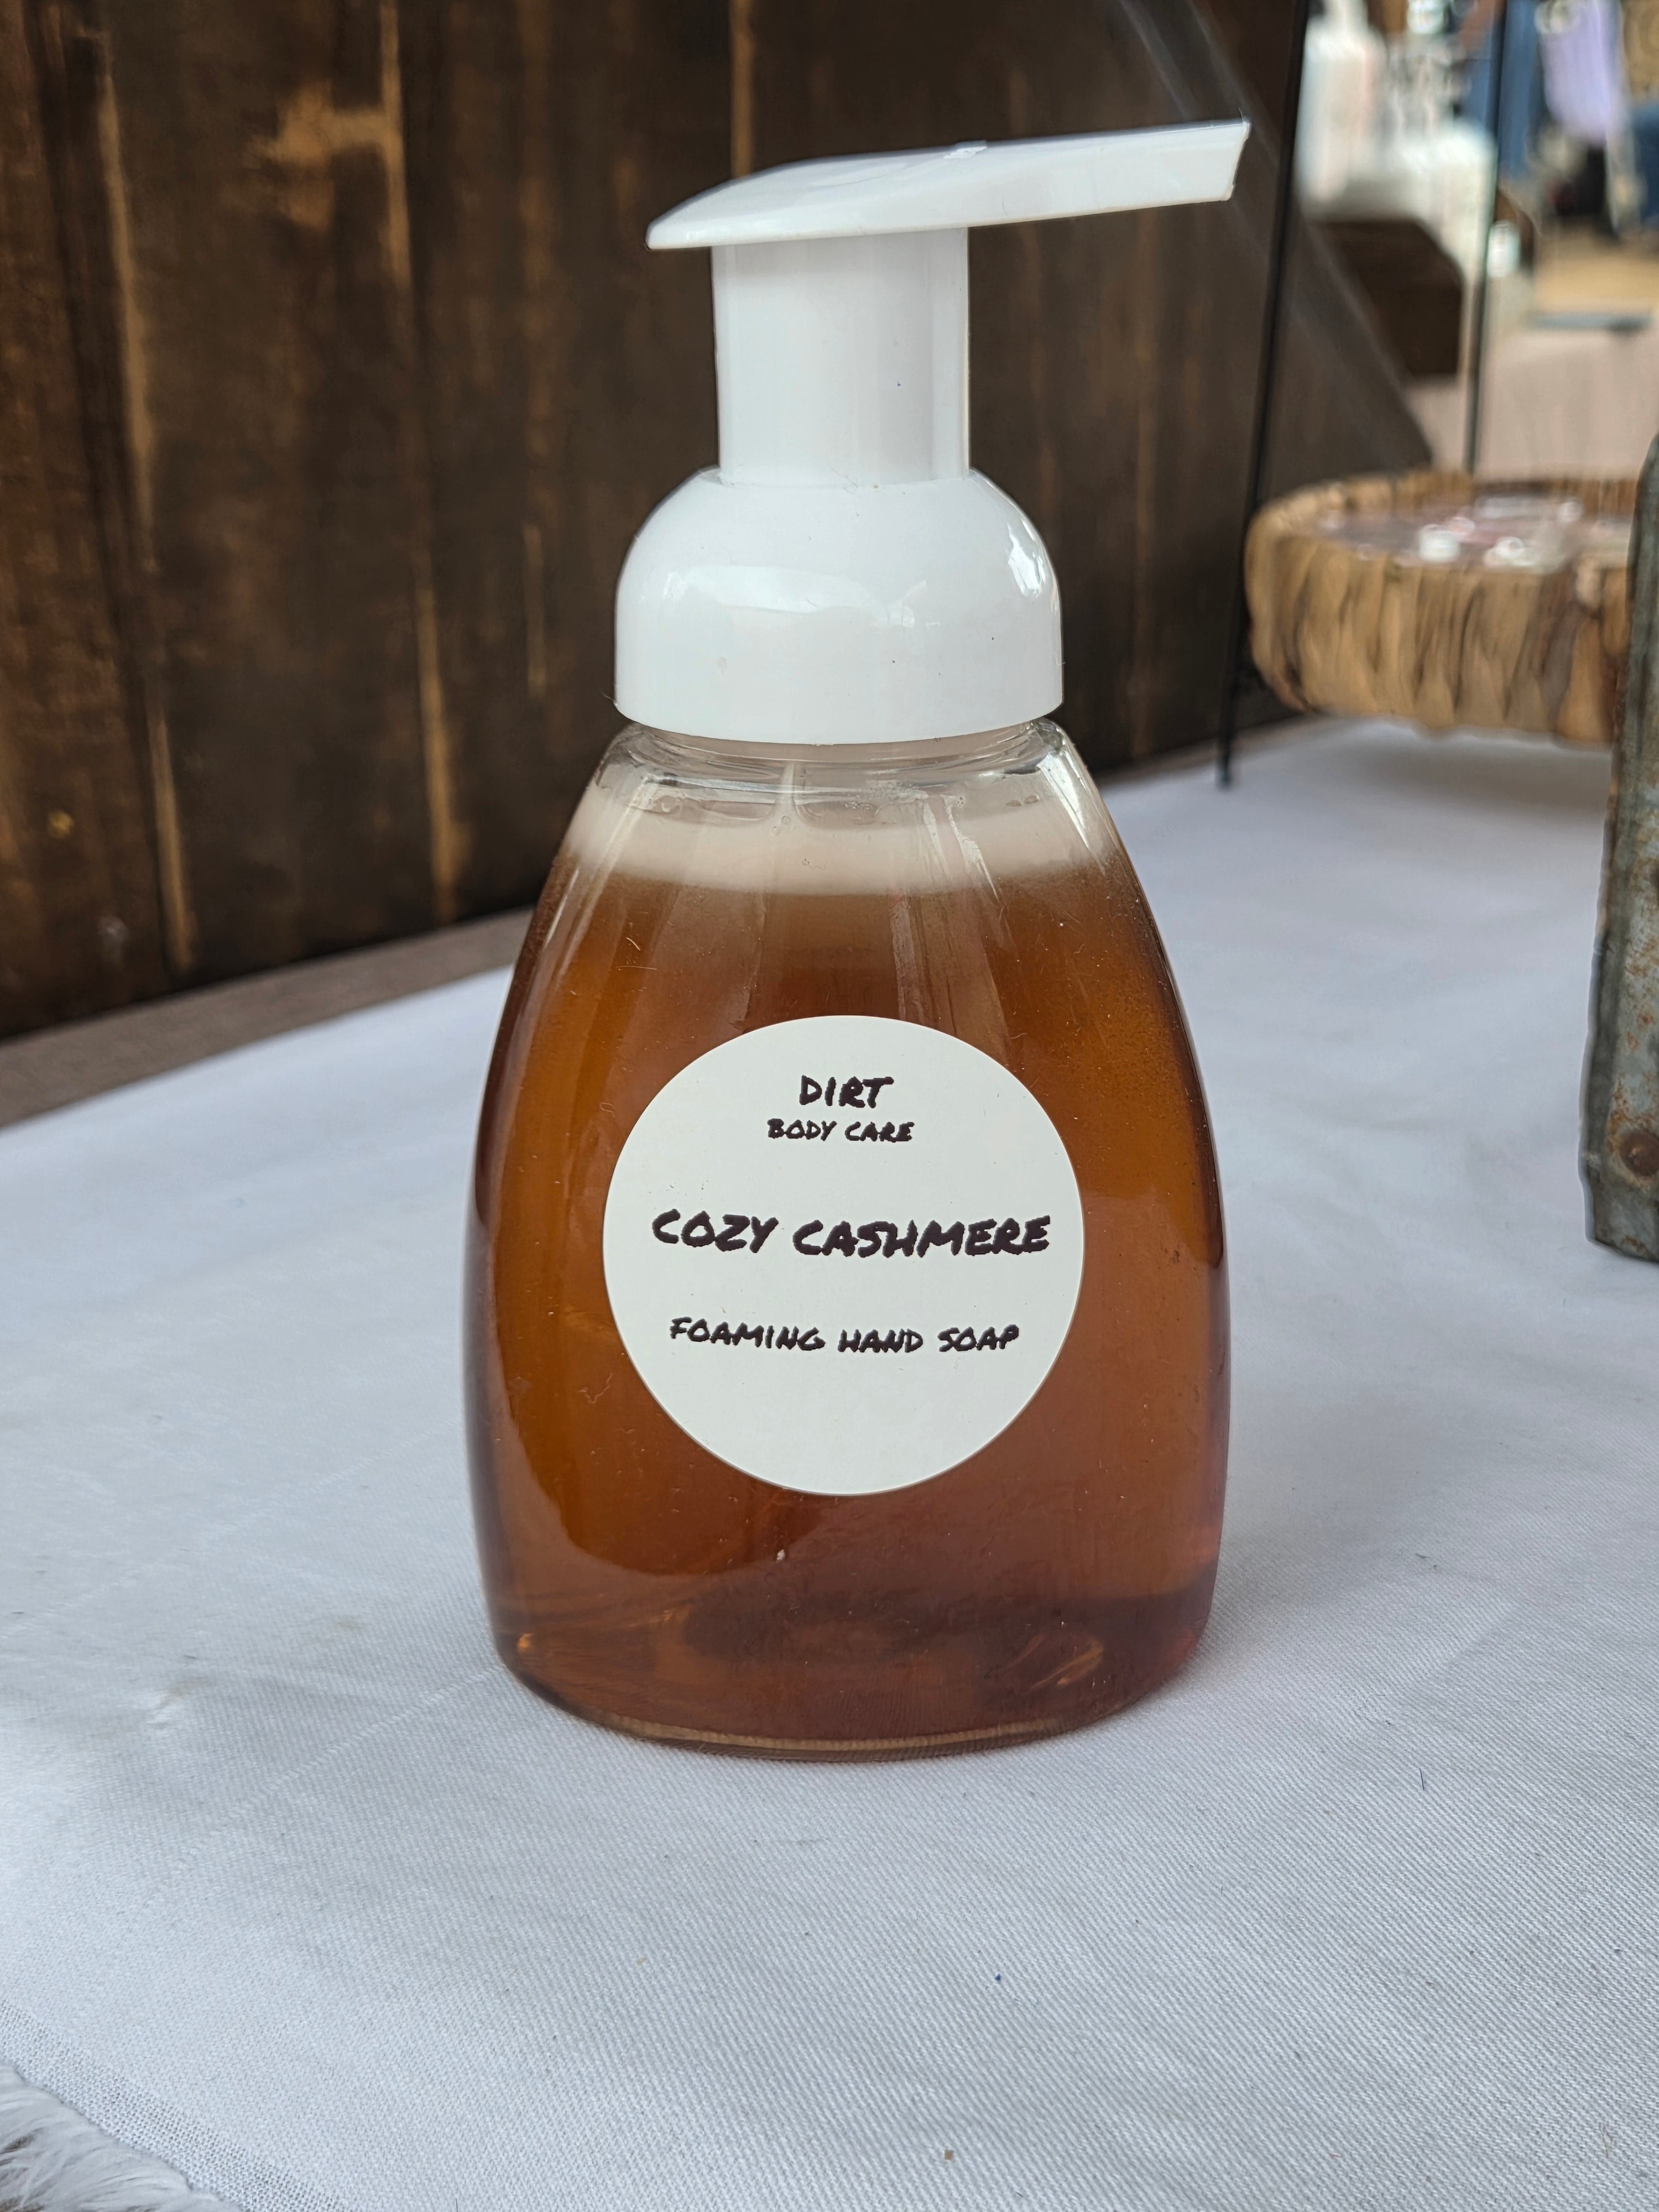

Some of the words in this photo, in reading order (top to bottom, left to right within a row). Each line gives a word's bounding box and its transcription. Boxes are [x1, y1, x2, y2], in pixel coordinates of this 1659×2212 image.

[800, 1075, 894, 1108] DIRT
[768, 1119, 837, 1141] BODY
[845, 1121, 914, 1142] CARE
[653, 1209, 779, 1253] COZY
[793, 1215, 1050, 1258] CASHMERE
[670, 1317, 826, 1351] FOAMING
[838, 1329, 923, 1353] HAND
[938, 1324, 1019, 1352] SOAP
